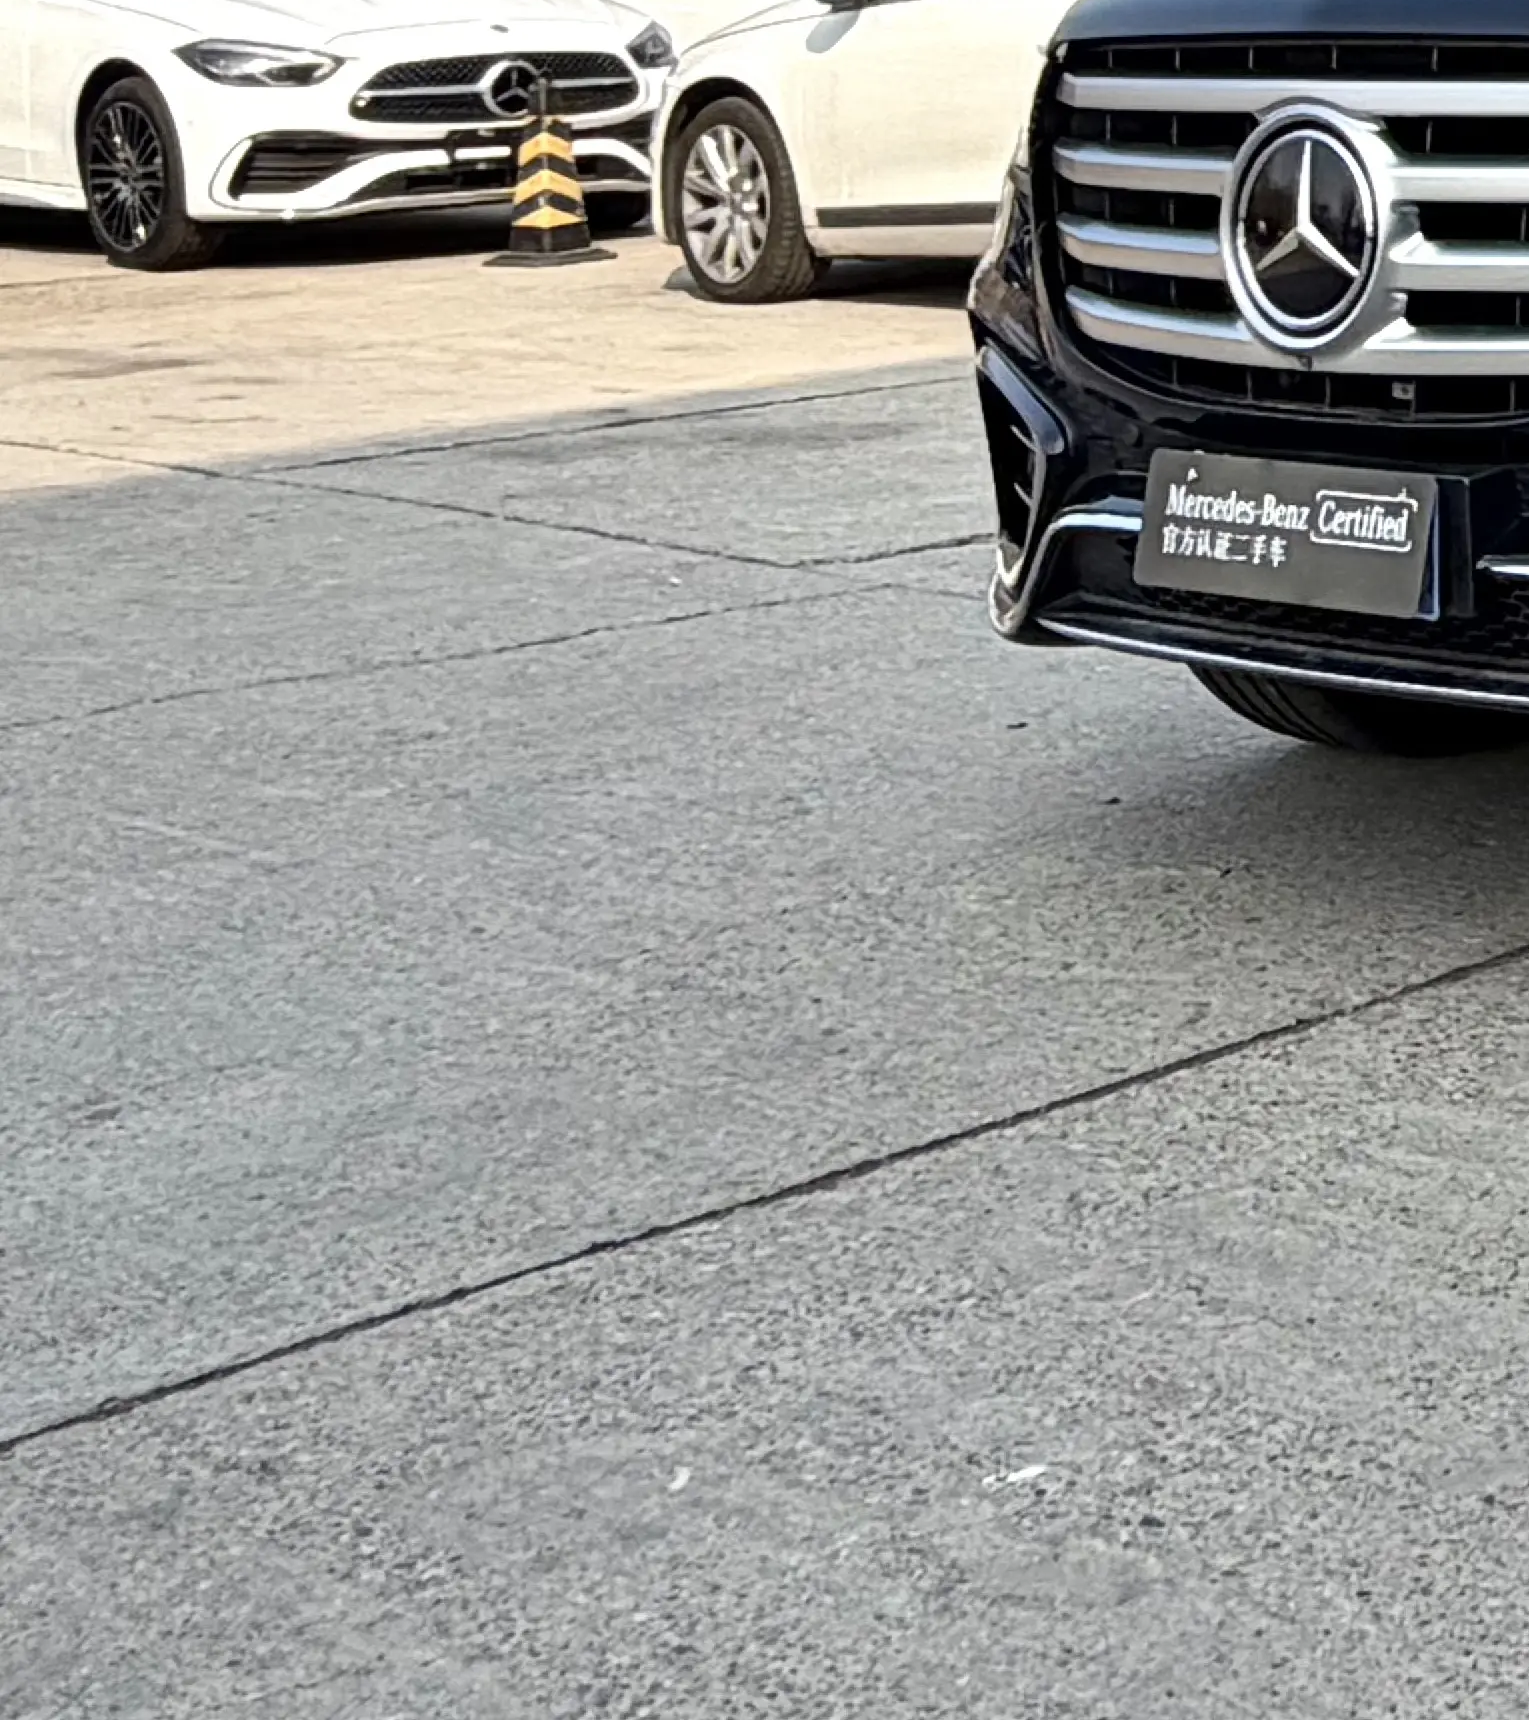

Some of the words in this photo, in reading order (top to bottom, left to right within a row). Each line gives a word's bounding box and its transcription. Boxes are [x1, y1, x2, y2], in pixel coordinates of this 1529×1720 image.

[1164, 483, 1310, 531] Mercedes-Benz
[1317, 499, 1409, 542] Certified
[1161, 523, 1288, 568] 官方认证二手车
